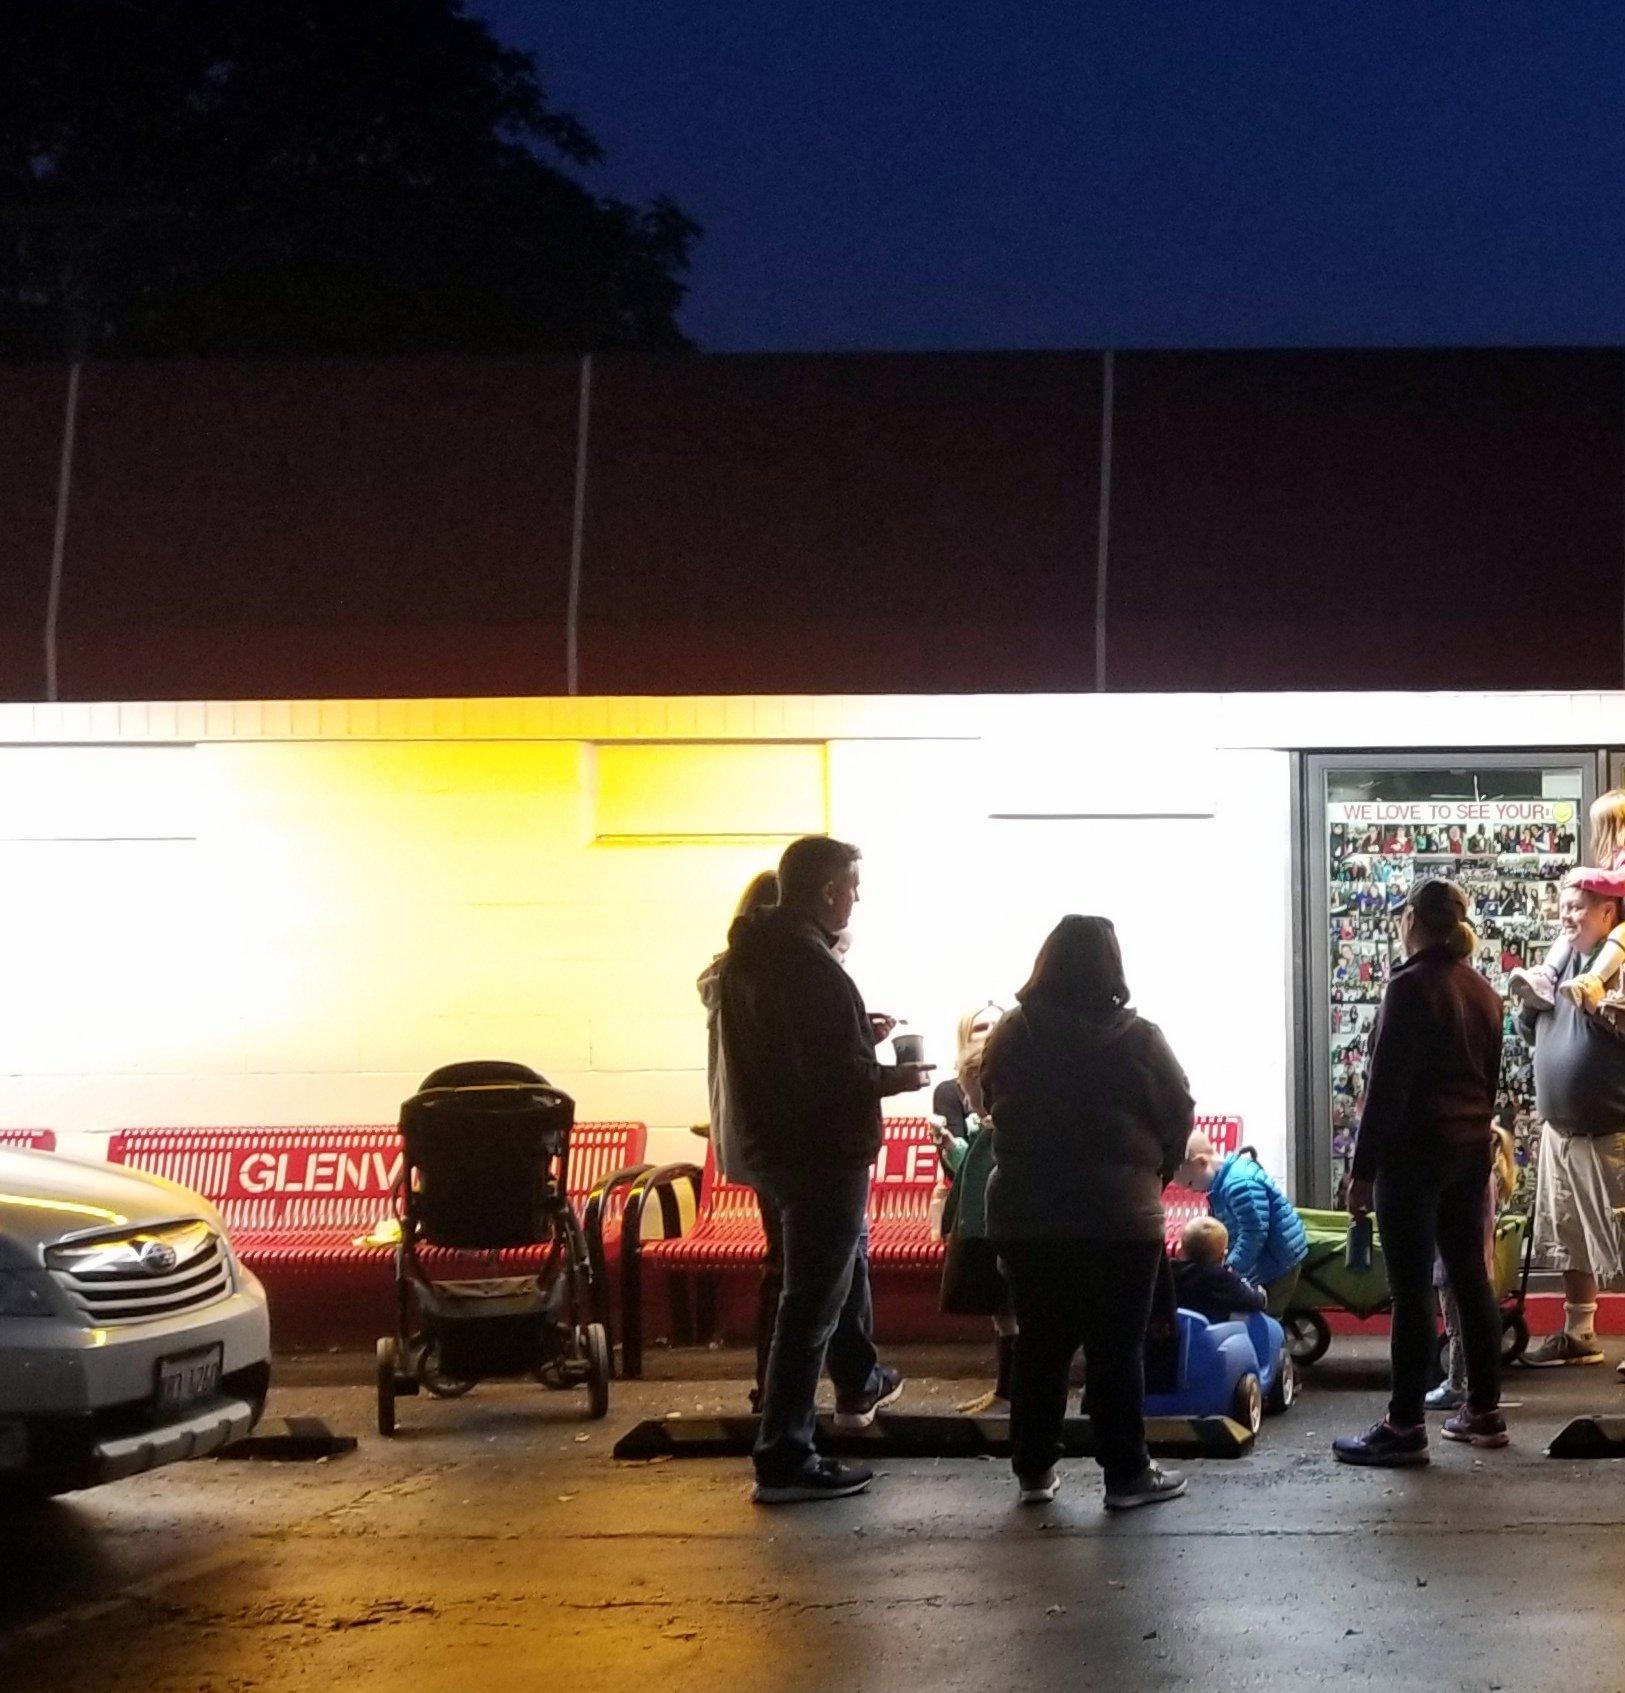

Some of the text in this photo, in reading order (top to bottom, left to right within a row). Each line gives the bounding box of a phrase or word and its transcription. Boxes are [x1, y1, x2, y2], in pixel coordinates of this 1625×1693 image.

[1344, 804, 1372, 820] WE
[1376, 804, 1421, 820] LOVE
[1428, 804, 1451, 819] TO
[1456, 804, 1490, 819] SEE
[238, 1151, 405, 1194] GLENV
